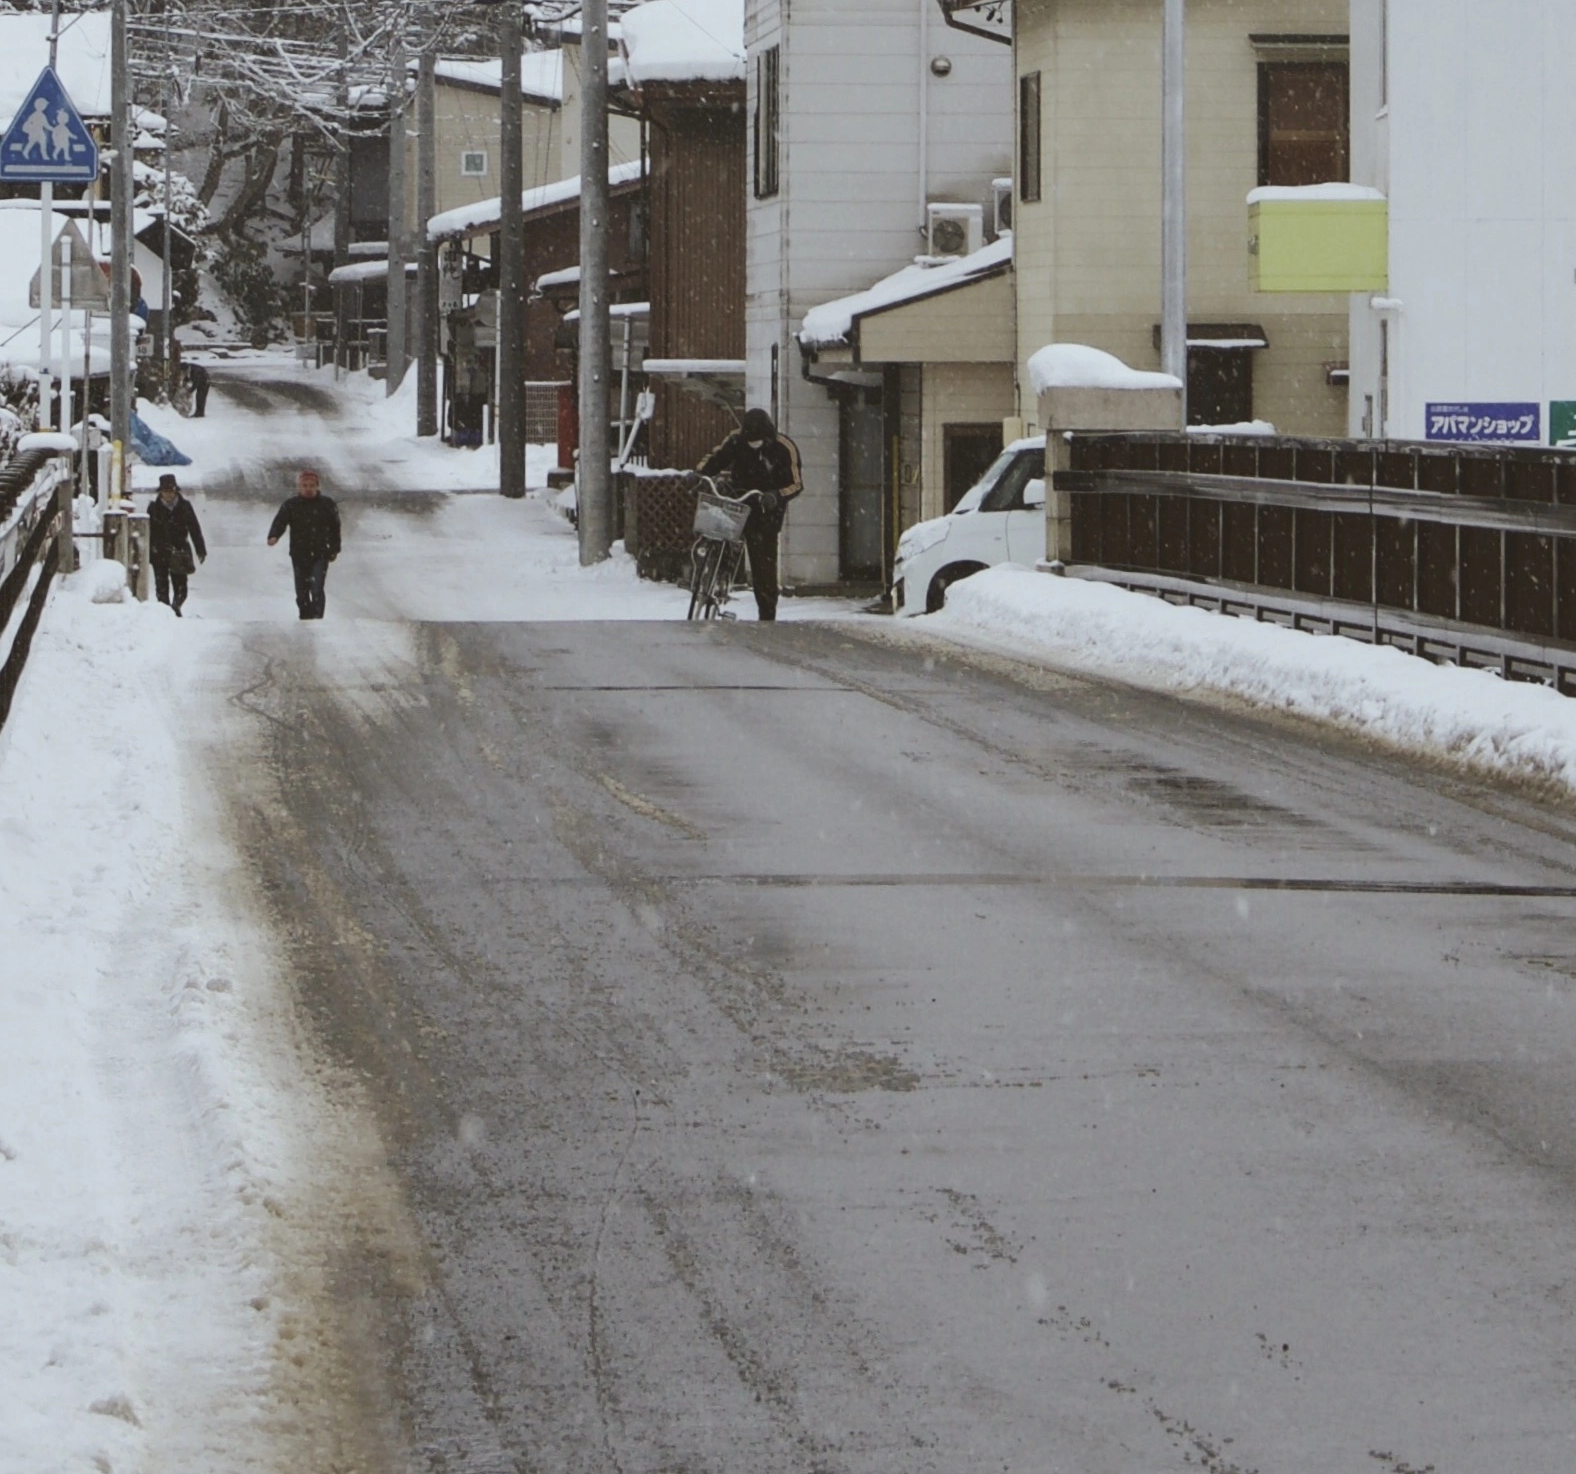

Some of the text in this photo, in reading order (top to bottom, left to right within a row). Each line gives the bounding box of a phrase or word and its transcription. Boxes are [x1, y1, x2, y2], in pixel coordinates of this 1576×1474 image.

[1430, 414, 1535, 434] アパマンショップ
